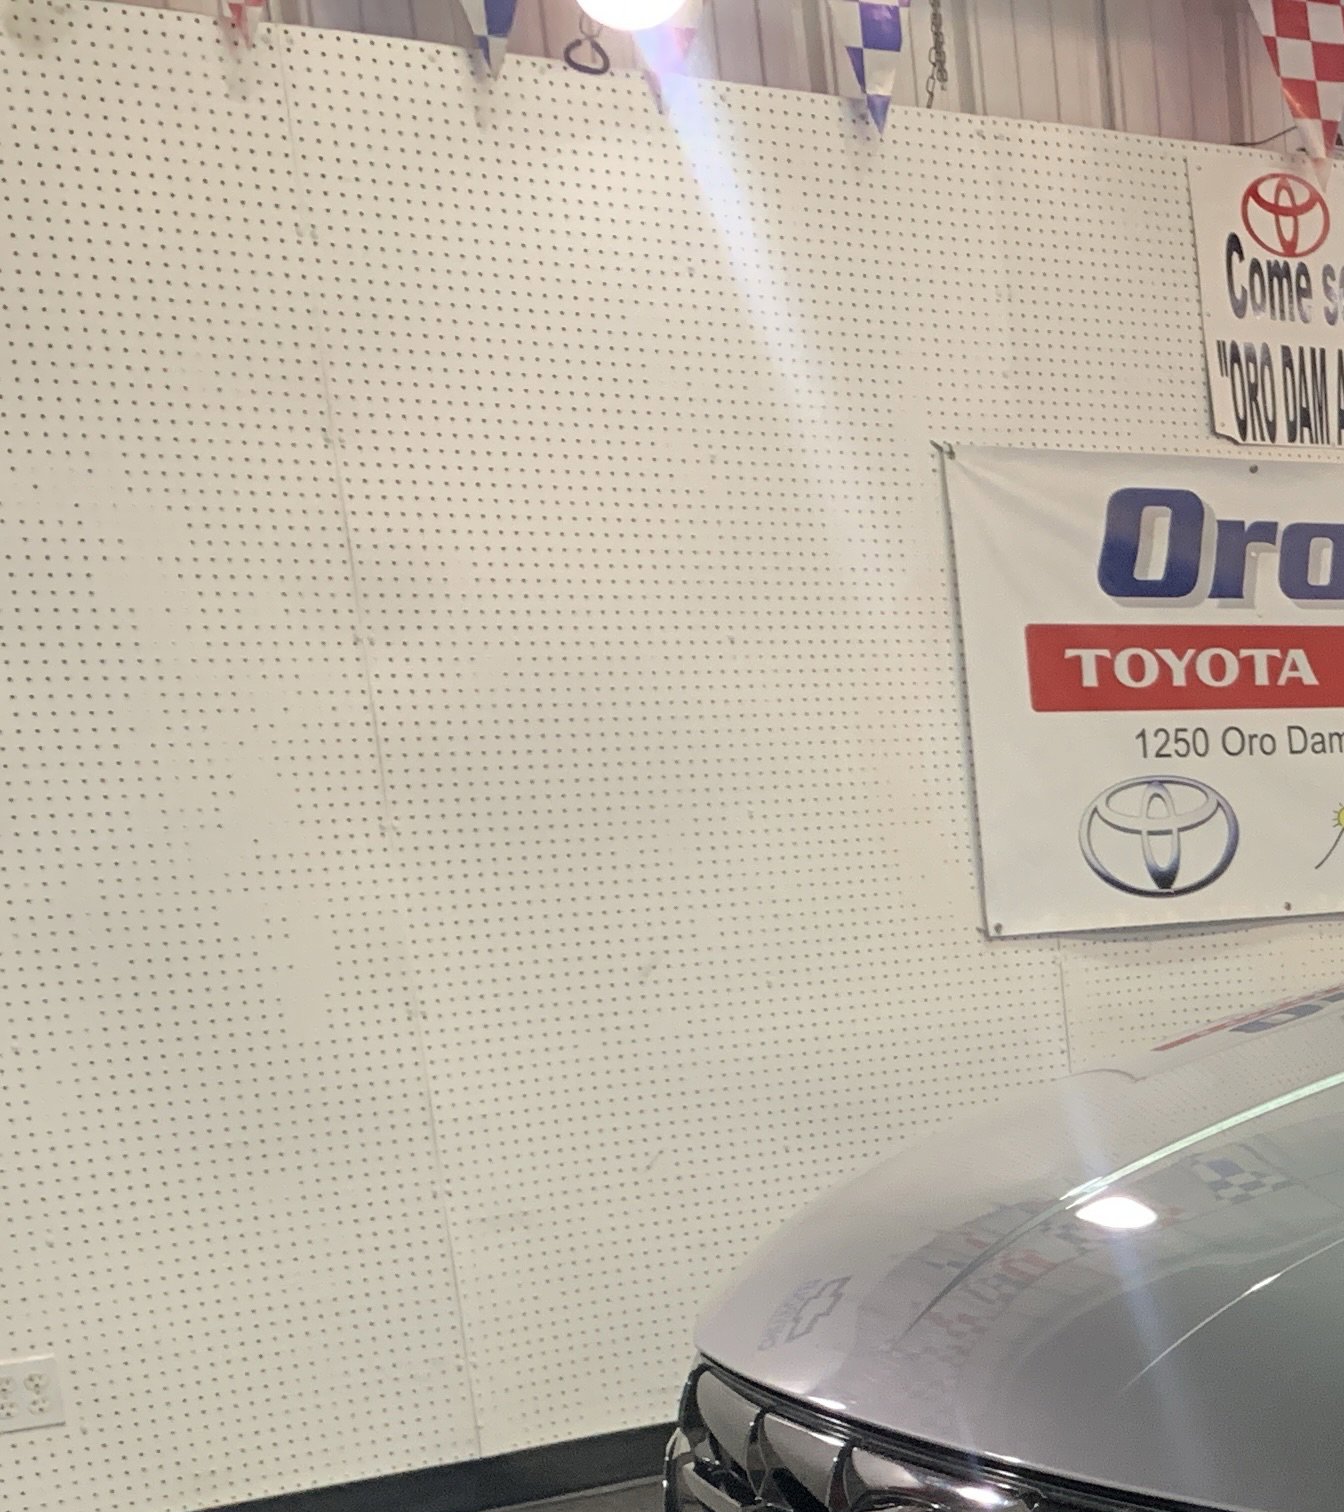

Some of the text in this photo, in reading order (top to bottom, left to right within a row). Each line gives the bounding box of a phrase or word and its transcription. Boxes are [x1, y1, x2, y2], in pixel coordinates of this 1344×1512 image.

[1226, 232, 1313, 324] Come
[1216, 339, 1277, 443] "ORO
[1281, 344, 1331, 445] DAM
[1065, 647, 1320, 689] TOYOTA
[1134, 727, 1210, 760] 1250
[1221, 728, 1277, 757] Oro
